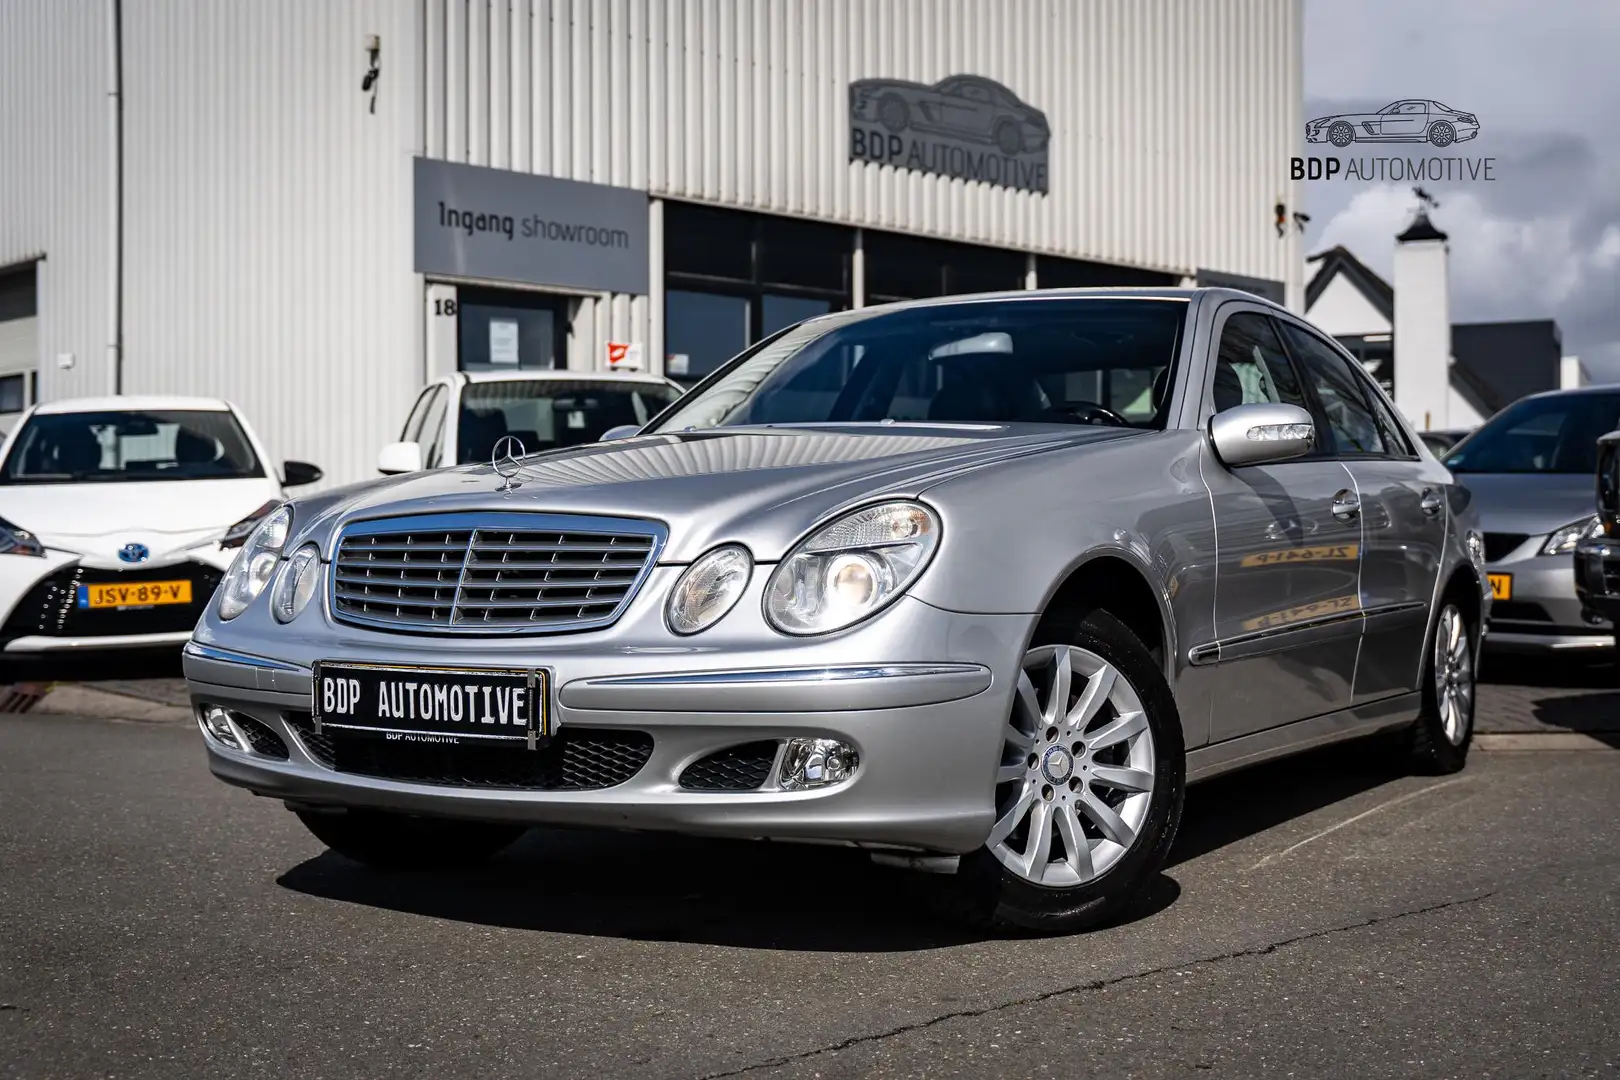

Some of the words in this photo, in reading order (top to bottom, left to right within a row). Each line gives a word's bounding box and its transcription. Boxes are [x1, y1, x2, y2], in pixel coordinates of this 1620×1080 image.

[852, 127, 903, 162] BDP
[907, 140, 1046, 190] AUTOMOTIVE
[521, 214, 629, 249] showroom
[434, 299, 457, 317] 18
[95, 584, 181, 604] JSV-89-V
[323, 677, 361, 715] BDP
[378, 681, 528, 726] AUTOMOTIVE
